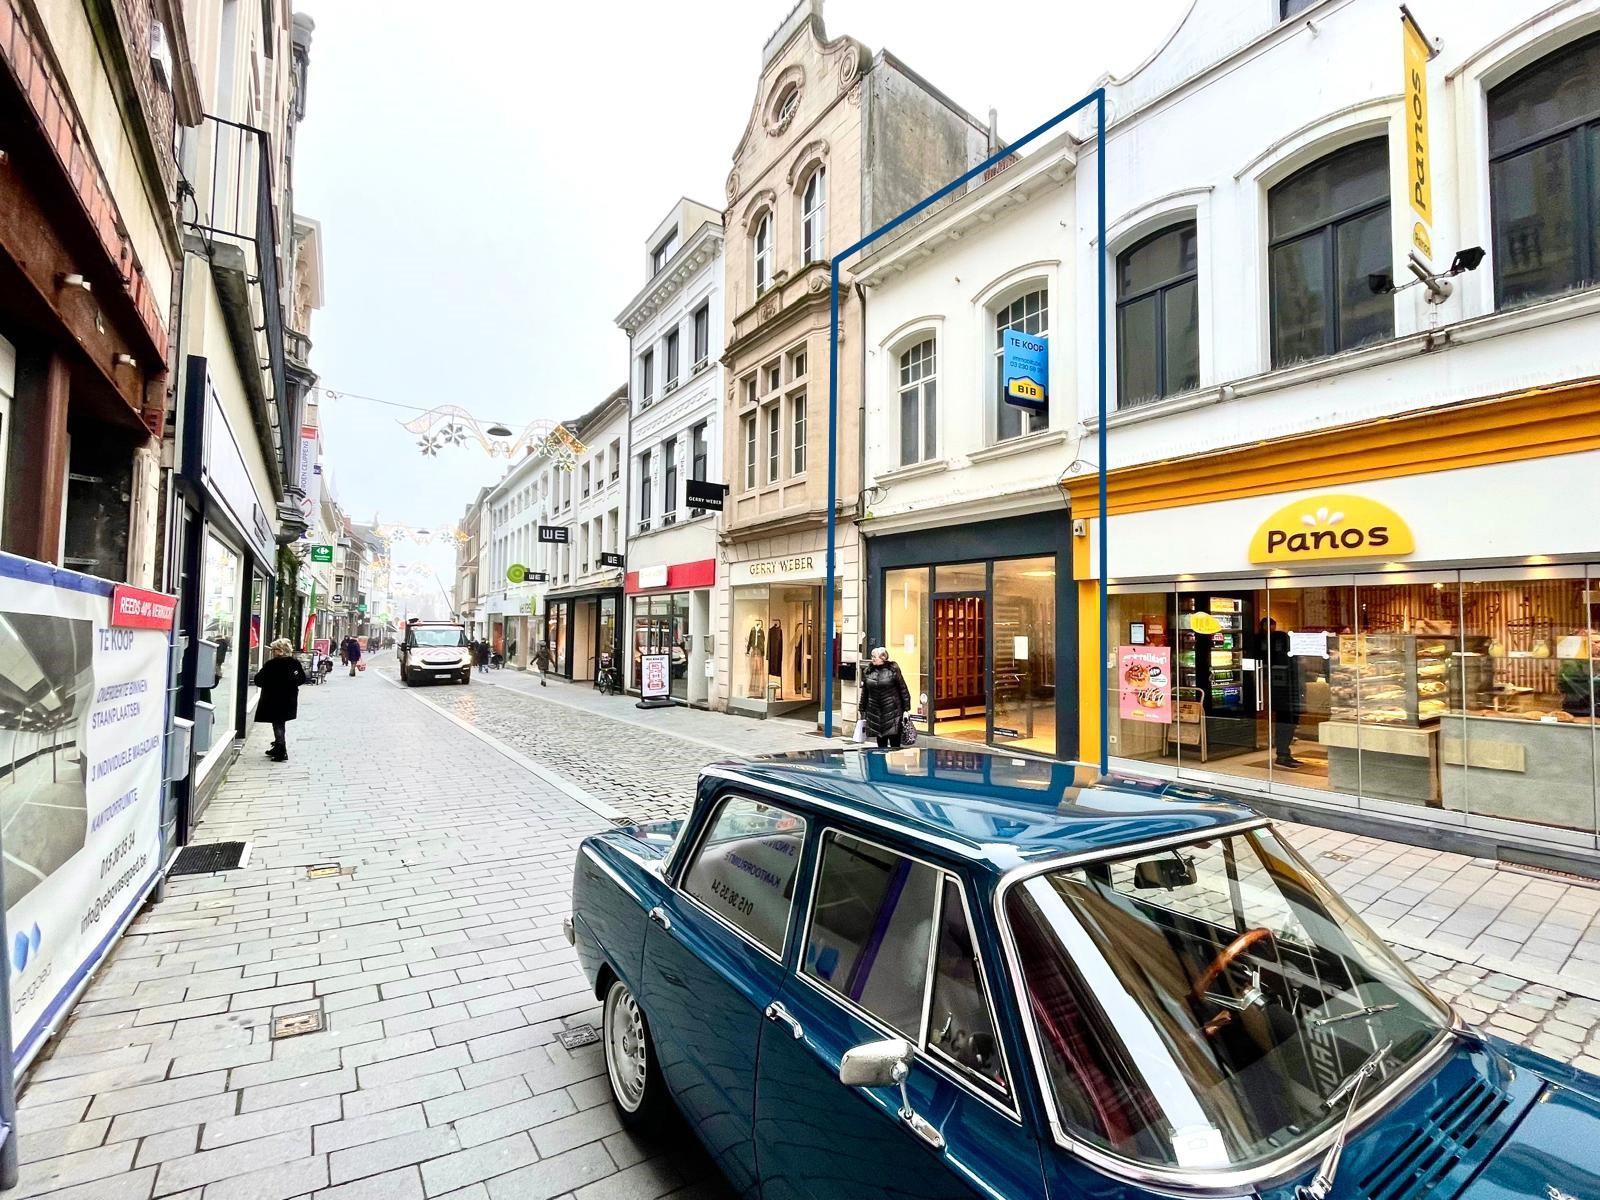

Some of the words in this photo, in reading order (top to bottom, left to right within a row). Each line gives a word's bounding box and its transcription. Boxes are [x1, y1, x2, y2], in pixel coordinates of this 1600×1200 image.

[1412, 68, 1426, 212] Panos
[1010, 337, 1020, 348] TE
[1022, 341, 1044, 353] KOOP
[1017, 385, 1037, 396] BIB
[542, 529, 565, 540] WE
[1267, 526, 1389, 554] Panos
[607, 555, 618, 564] WE
[750, 561, 777, 575] GERRY
[779, 556, 814, 572] WEBER
[528, 573, 541, 581] WE
[120, 596, 141, 615] REEDS
[98, 628, 109, 651] TE
[111, 629, 134, 651] KOOP
[92, 702, 141, 730] STAANPLAATSEN
[100, 852, 113, 880] 015
